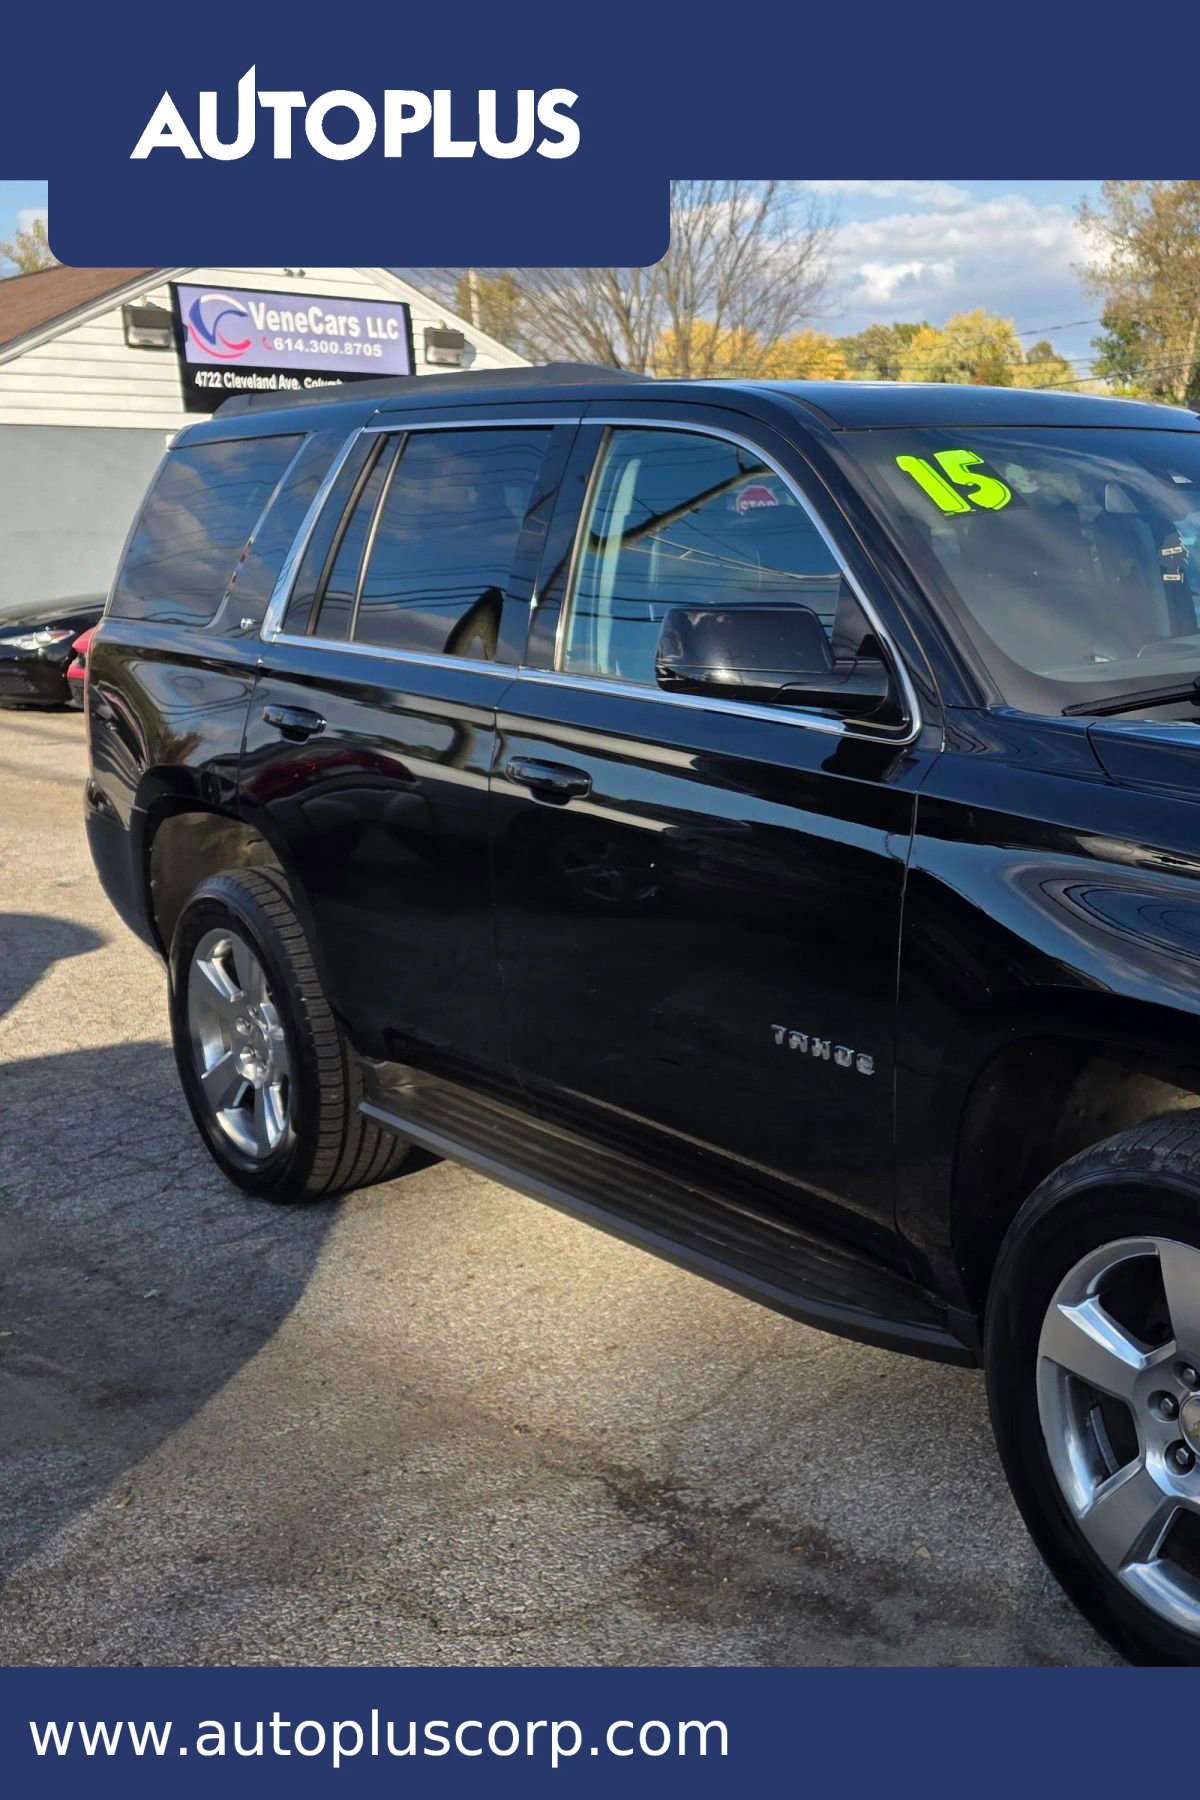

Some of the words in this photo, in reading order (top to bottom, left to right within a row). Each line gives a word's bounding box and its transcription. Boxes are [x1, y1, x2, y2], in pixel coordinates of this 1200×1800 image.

[248, 301, 361, 337] VeneCars
[366, 316, 399, 340] LLC
[273, 337, 383, 357] 614.300.8705
[195, 370, 222, 388] 4722
[223, 372, 277, 390] Cleveland
[896, 450, 1011, 512] 15
[771, 1024, 875, 1075] TAHOE
